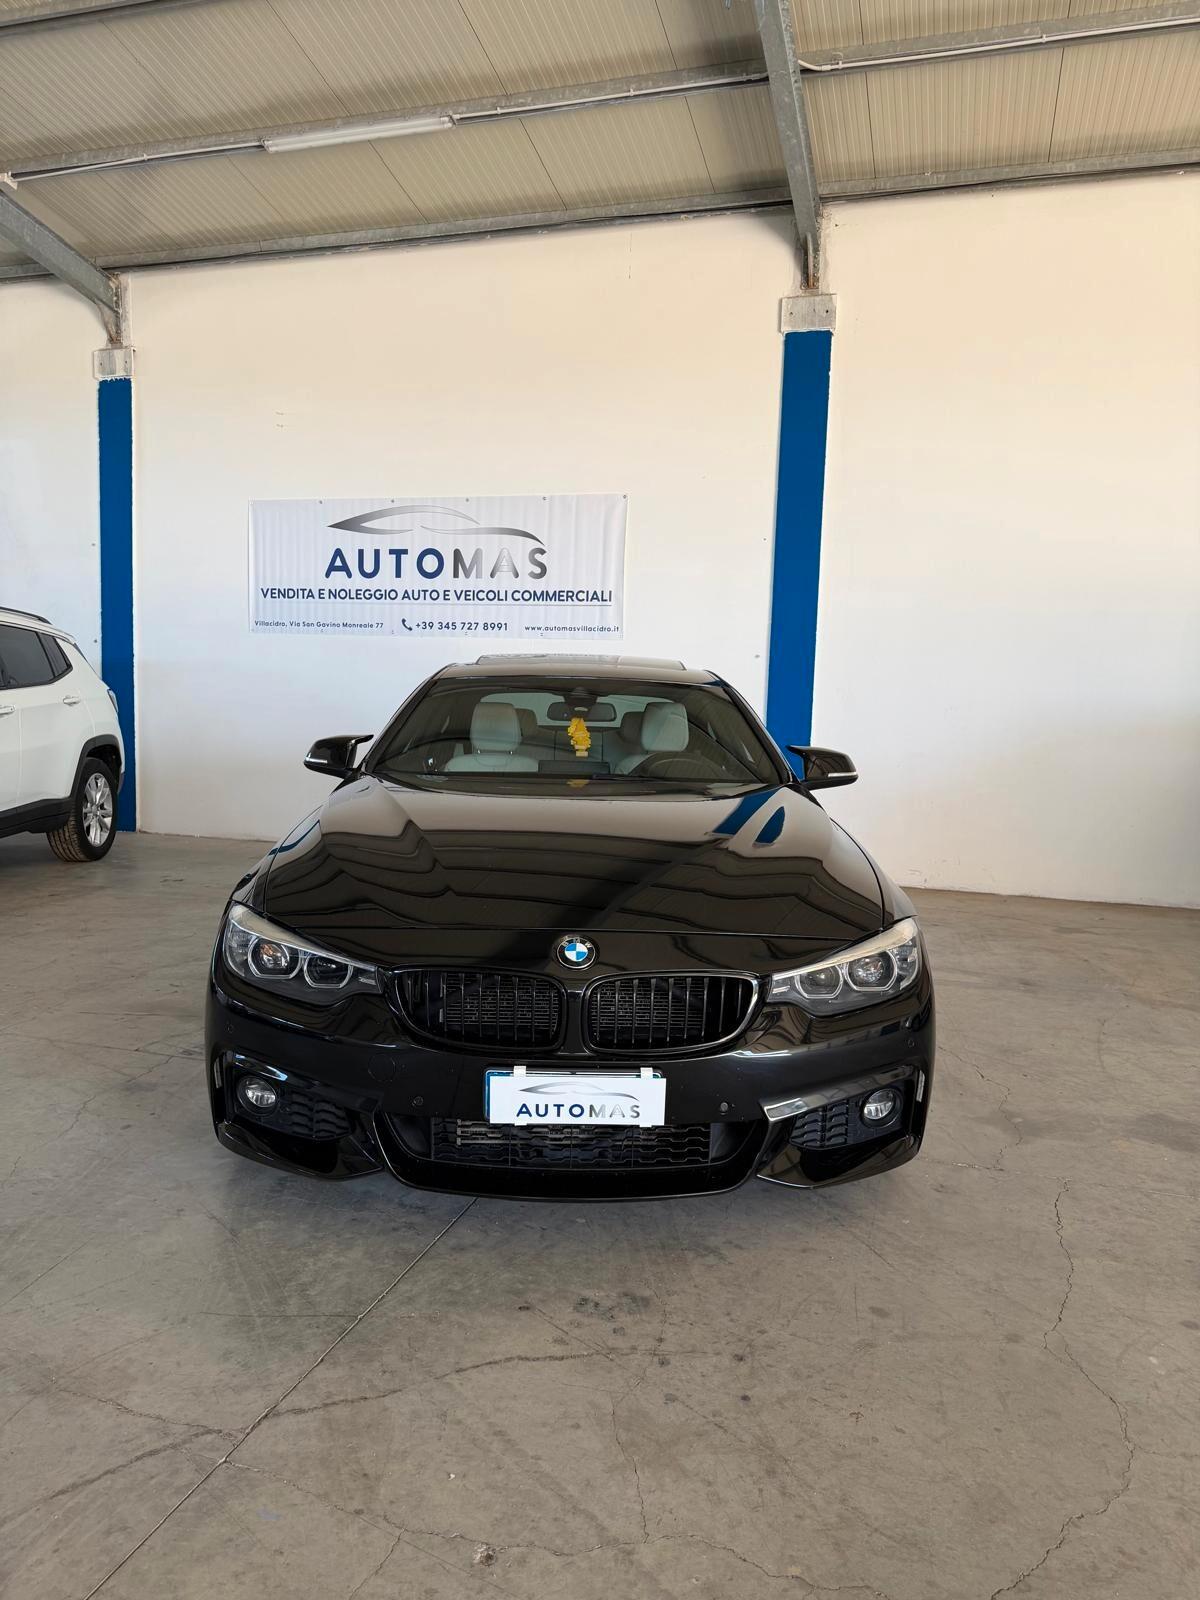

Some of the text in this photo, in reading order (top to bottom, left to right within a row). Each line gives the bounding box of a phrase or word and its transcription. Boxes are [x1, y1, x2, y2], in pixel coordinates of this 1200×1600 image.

[325, 547, 547, 580] AUTOMAS
[261, 588, 612, 602] VENDITA E NOLEGGIO AUTO E VEICOLI COMMERCIALI
[254, 620, 288, 628] Villacidro,
[289, 620, 300, 628] Via
[316, 621, 341, 629] Gavino
[342, 621, 374, 629] Monreale
[415, 621, 508, 632] +39 345 727 8991
[524, 624, 620, 633] www.automasvillacidro.it
[516, 1103, 640, 1119] AUTOMAS
